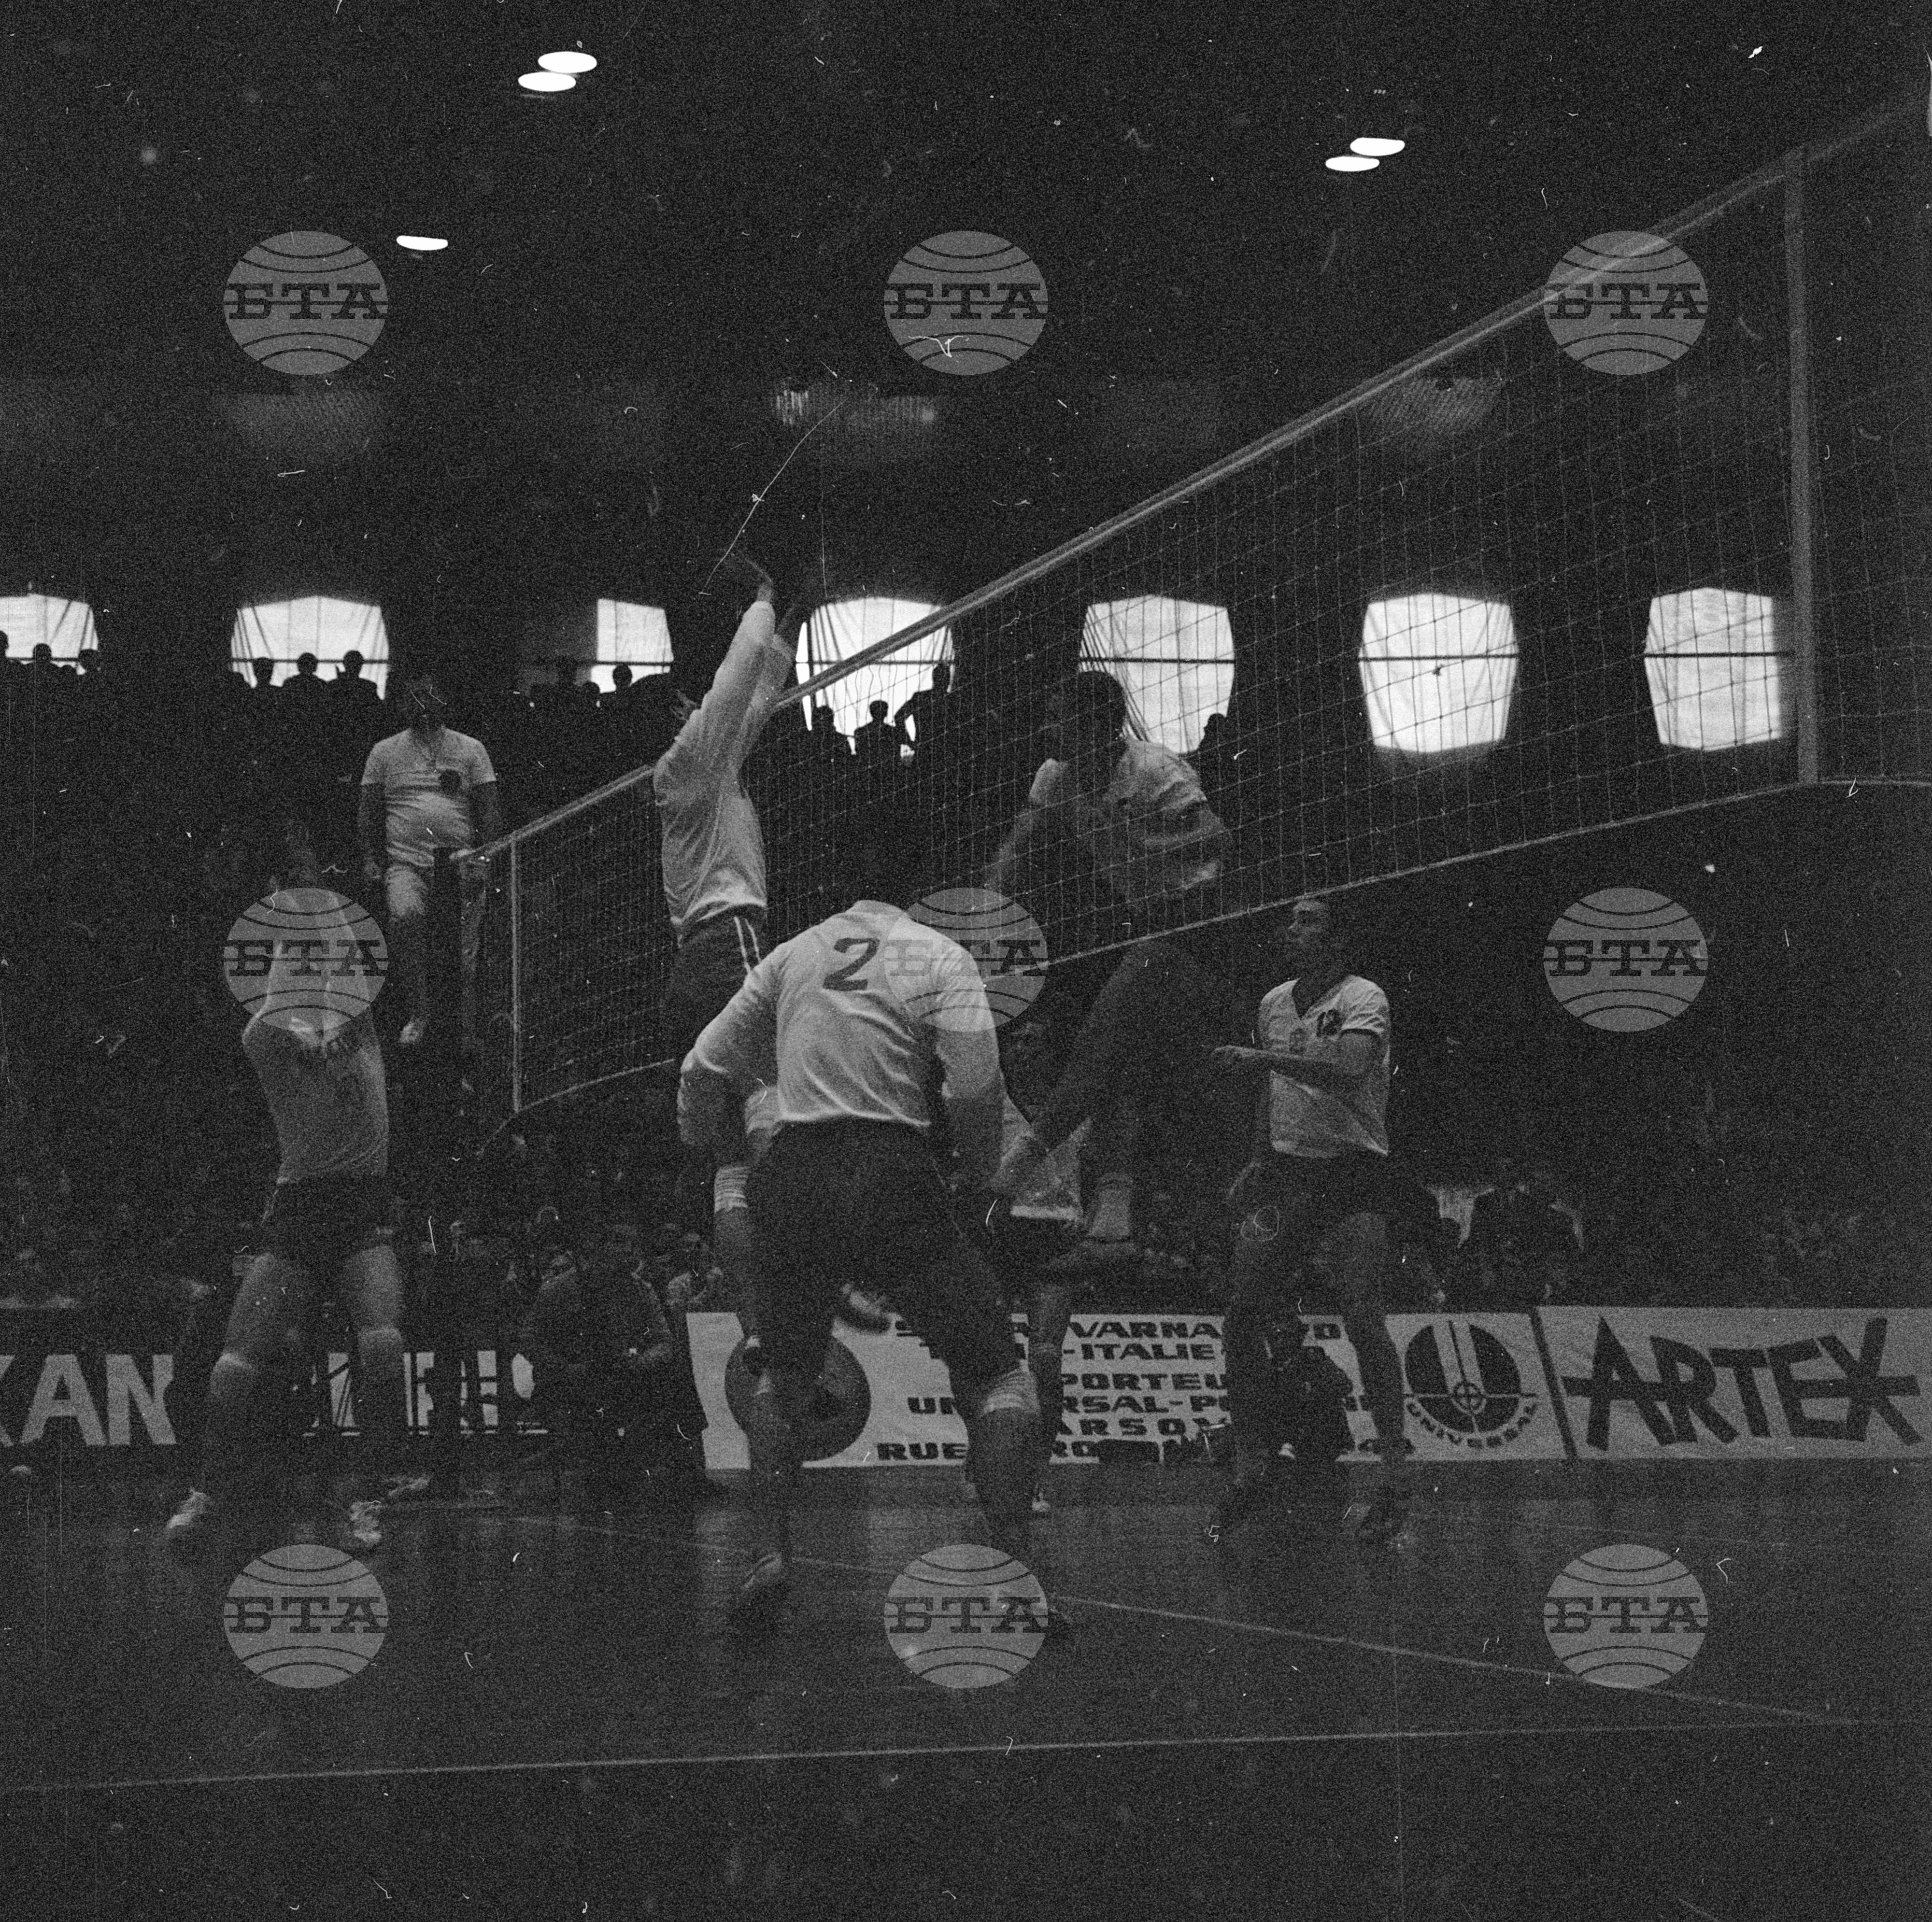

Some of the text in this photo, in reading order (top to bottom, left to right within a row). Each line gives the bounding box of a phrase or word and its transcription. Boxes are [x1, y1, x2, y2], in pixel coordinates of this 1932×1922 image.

[823, 937, 880, 991] 2
[1068, 1322, 1222, 1338] VARNA
[0, 1354, 177, 1446] AN
[1561, 1315, 1924, 1450] ARTEX
[877, 1442, 967, 1460] RUE
